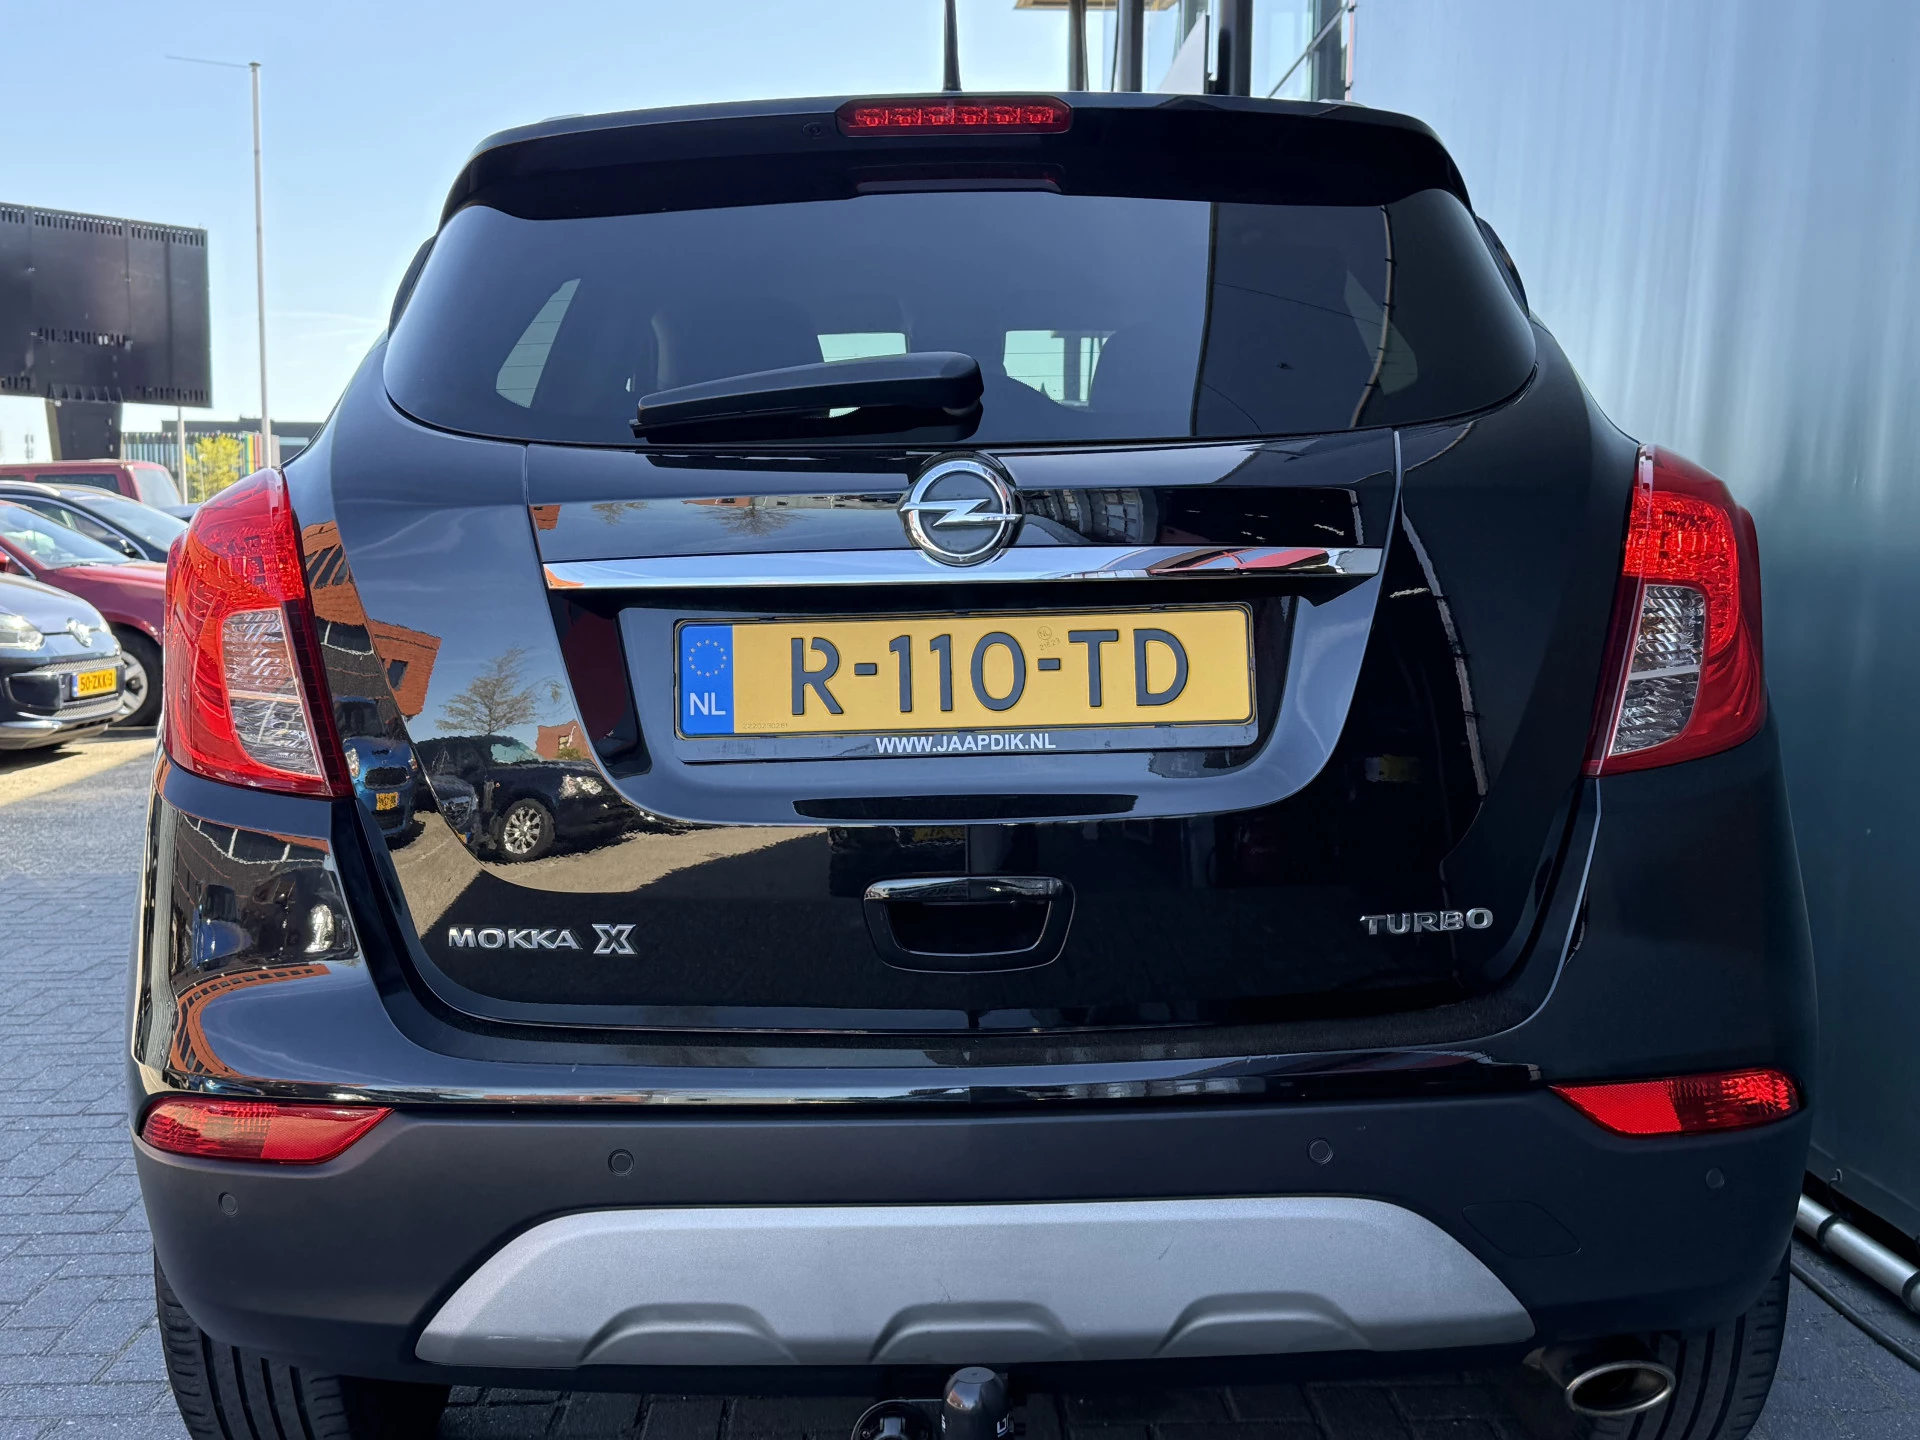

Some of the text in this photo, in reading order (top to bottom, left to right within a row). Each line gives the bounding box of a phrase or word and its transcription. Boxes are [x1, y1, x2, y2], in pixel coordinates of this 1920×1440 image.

[80, 672, 113, 691] 50-ZKK-3
[790, 627, 1189, 716] R-110-TD
[689, 692, 727, 716] NL
[876, 733, 1056, 754] WWW.JAAPDIK.NL
[1359, 907, 1494, 936] TURBO
[448, 923, 638, 955] MOKKA X
